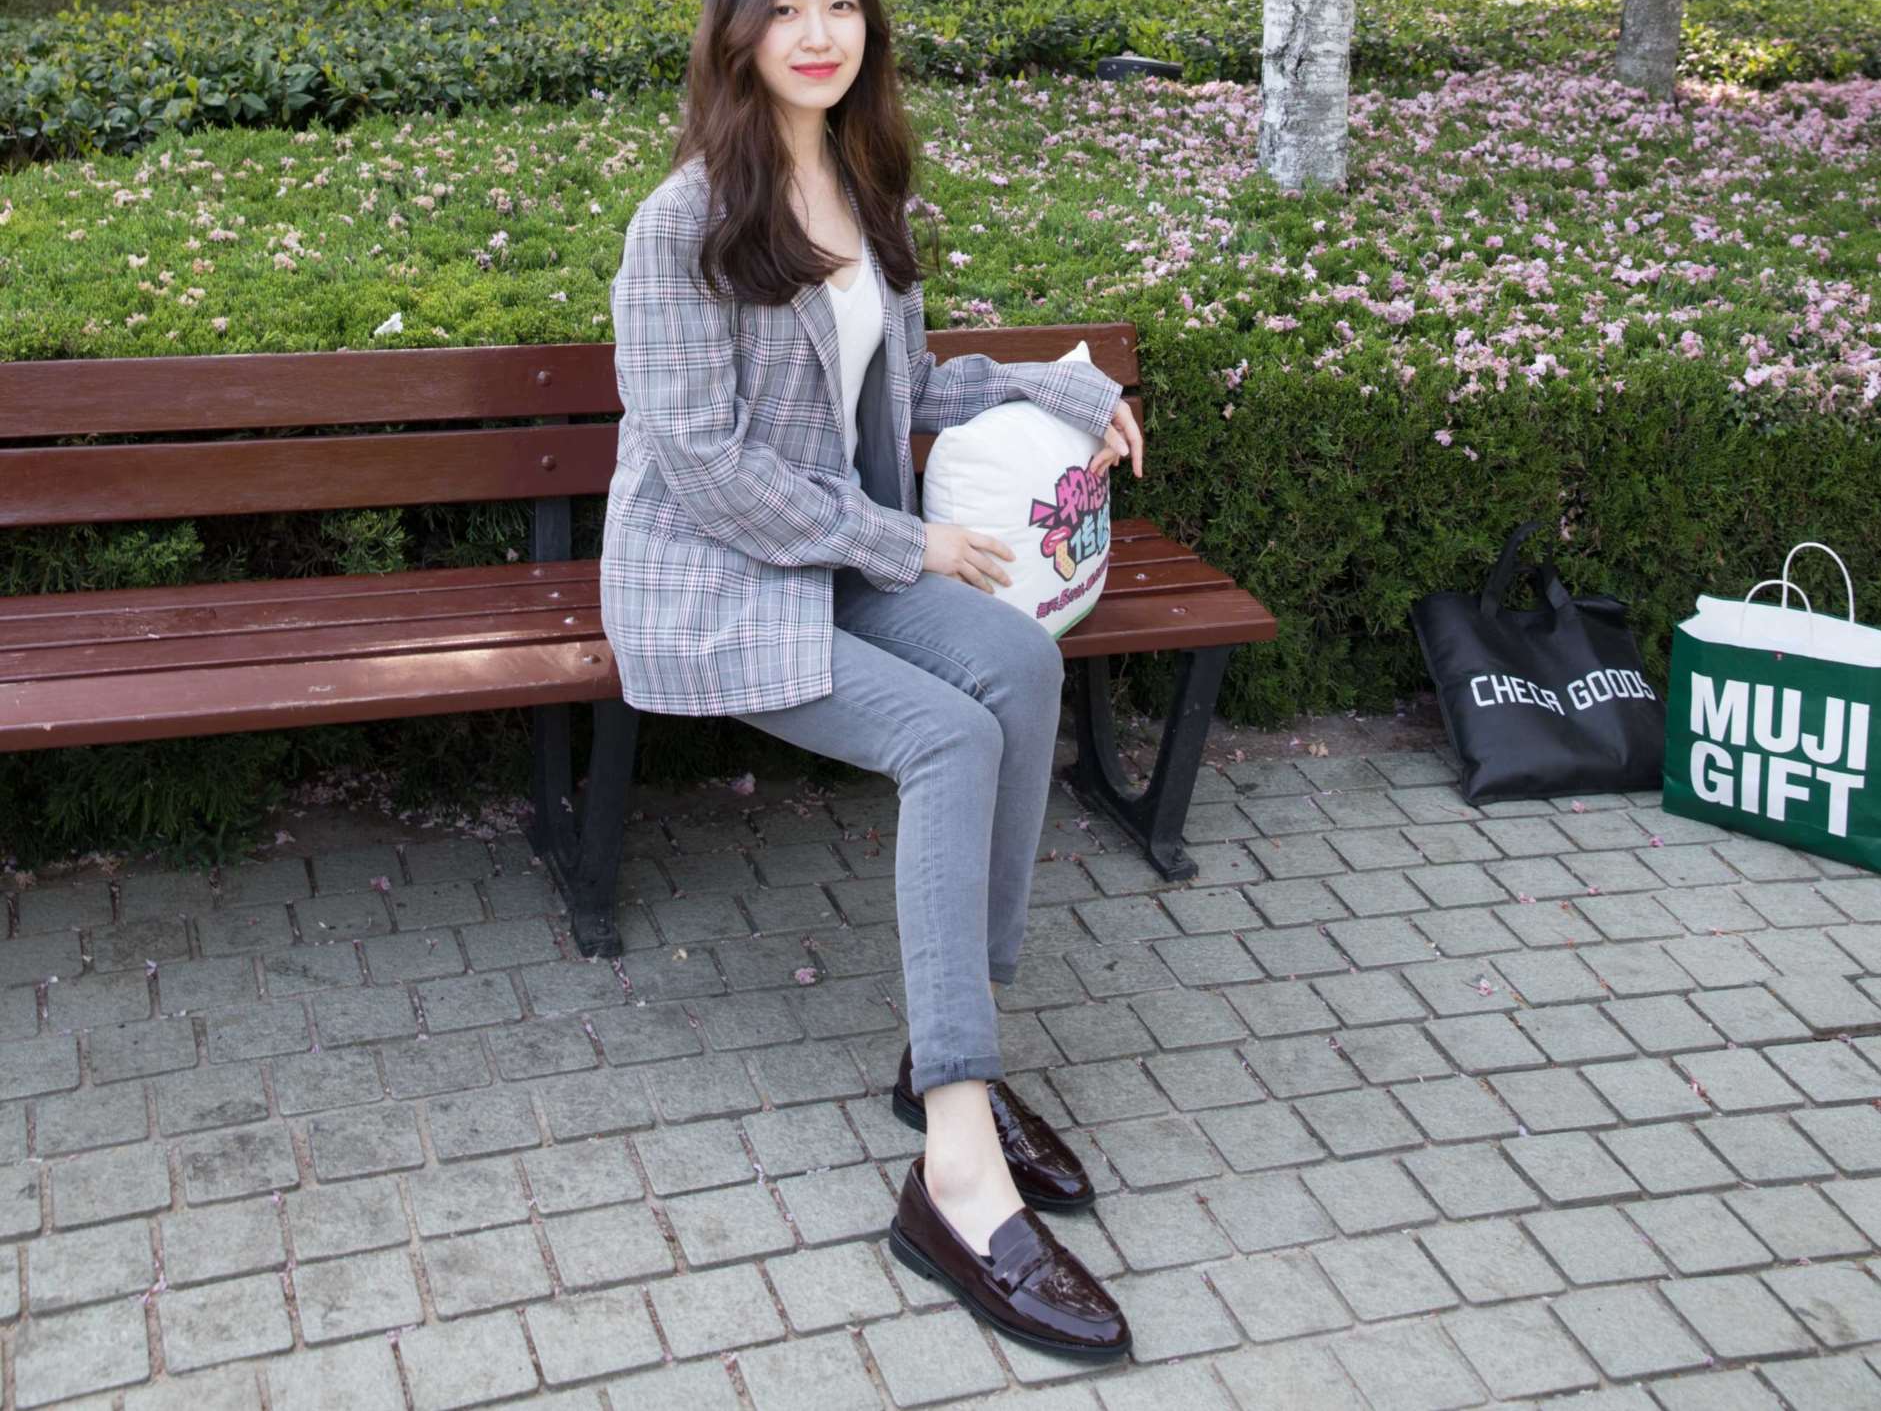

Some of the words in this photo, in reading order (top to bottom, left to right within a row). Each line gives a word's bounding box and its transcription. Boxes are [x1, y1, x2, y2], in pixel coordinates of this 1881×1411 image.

[1567, 669, 1656, 711] GOODS
[1690, 671, 1870, 771] MUJI
[1690, 740, 1865, 837] GIFT
